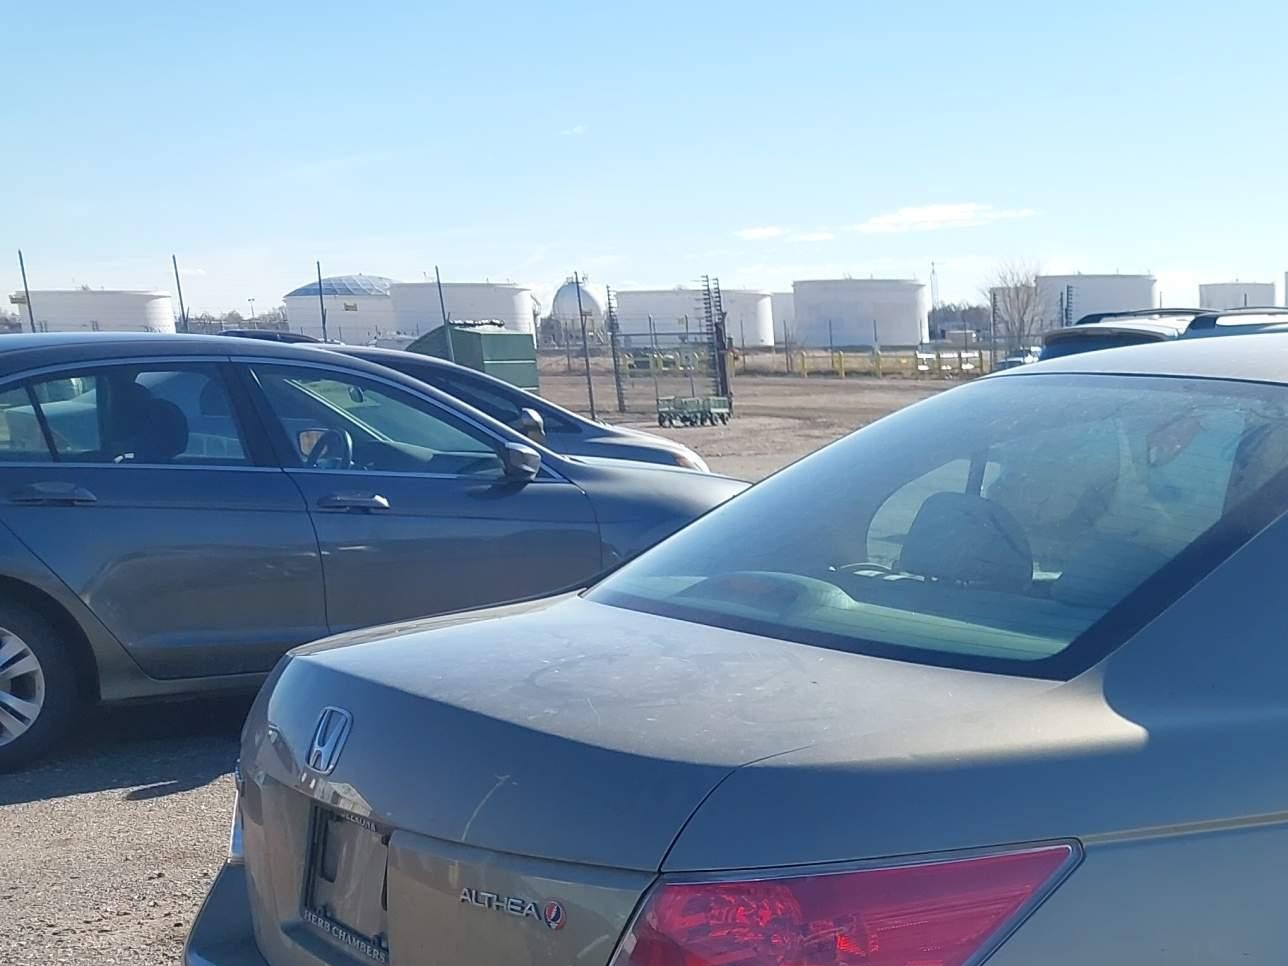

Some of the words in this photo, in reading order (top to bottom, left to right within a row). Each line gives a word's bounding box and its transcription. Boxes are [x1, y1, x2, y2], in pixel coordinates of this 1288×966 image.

[460, 887, 542, 921] ALTHEA
[303, 909, 331, 933] HERB
[331, 925, 386, 964] CHAMBERS
